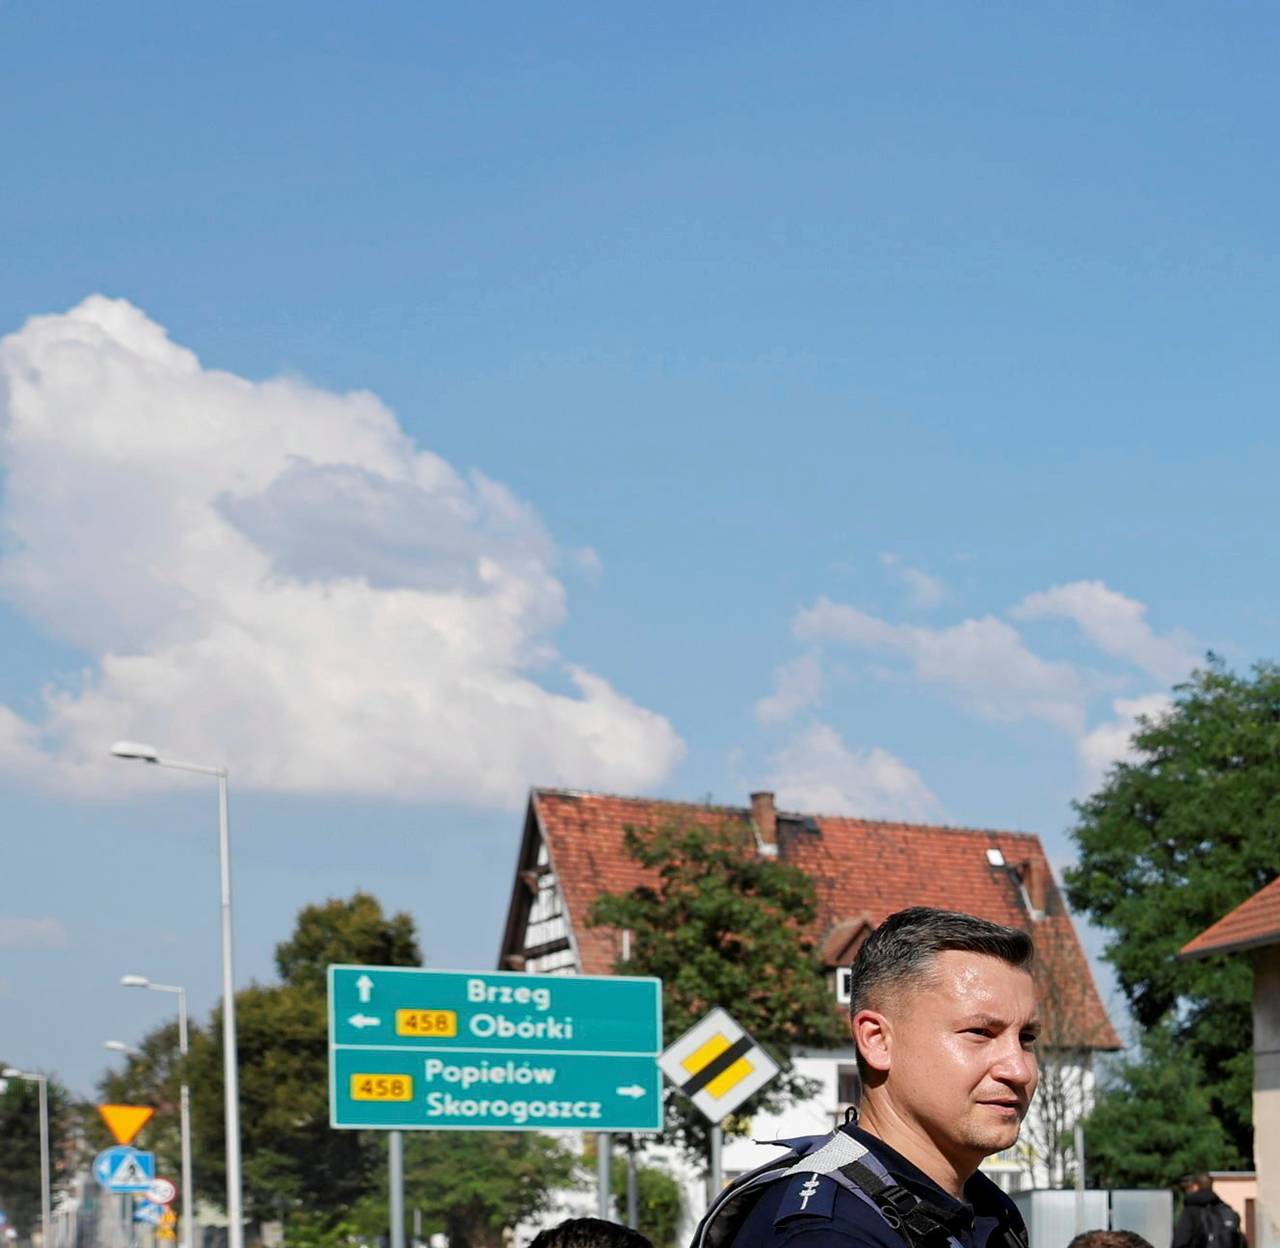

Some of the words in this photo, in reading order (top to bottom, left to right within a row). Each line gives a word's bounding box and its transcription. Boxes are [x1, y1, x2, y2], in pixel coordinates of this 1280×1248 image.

[466, 978, 551, 1010] Brzeg
[404, 1014, 450, 1032] 458
[469, 1013, 573, 1040] Obórki
[359, 1080, 405, 1097] 458
[425, 1059, 556, 1089] Popielów
[427, 1092, 602, 1124] Skorogoszcz
